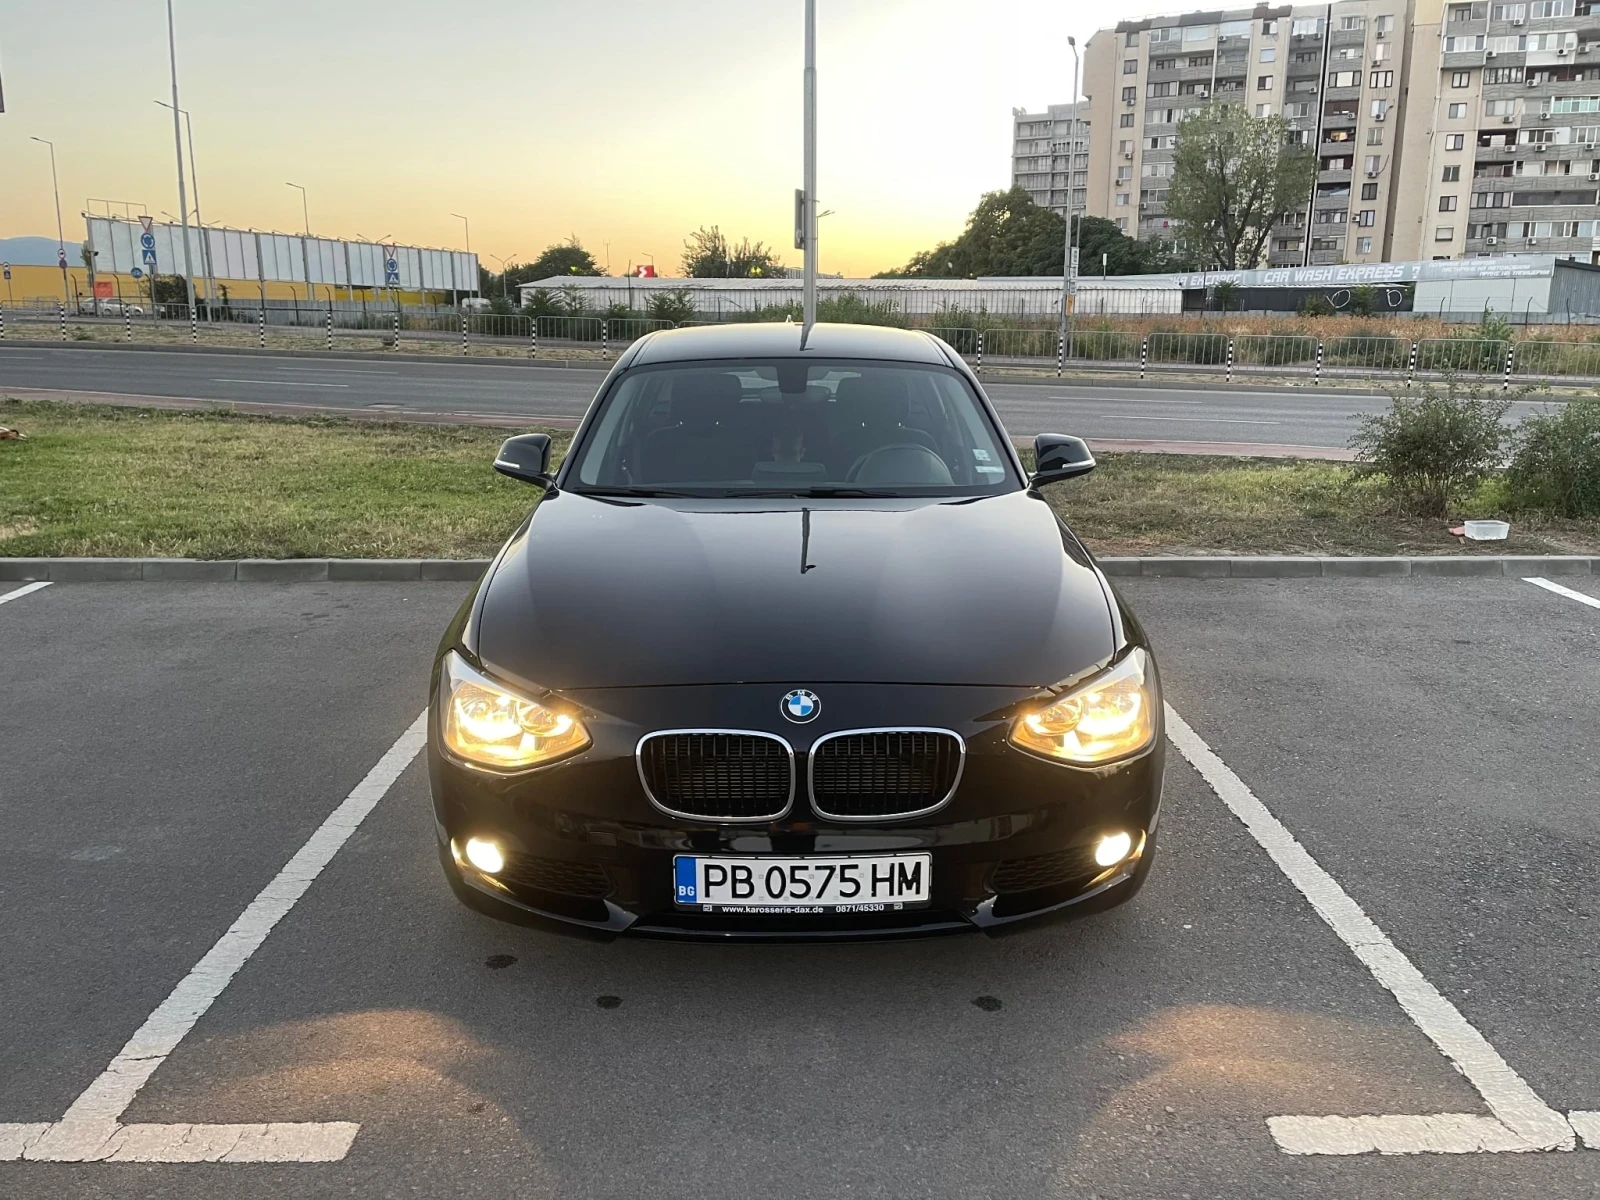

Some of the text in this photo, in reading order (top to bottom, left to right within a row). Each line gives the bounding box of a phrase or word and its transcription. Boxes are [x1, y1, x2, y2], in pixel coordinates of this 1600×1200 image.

[1264, 271, 1289, 283] CAR
[1294, 268, 1333, 282] WASH
[1336, 265, 1404, 280] EXPRESS
[785, 690, 819, 701] BMW
[704, 861, 921, 899] PB 0575 HM
[678, 886, 695, 896] BG
[721, 903, 885, 914] www.karosserie-dax.de 0871/45330
